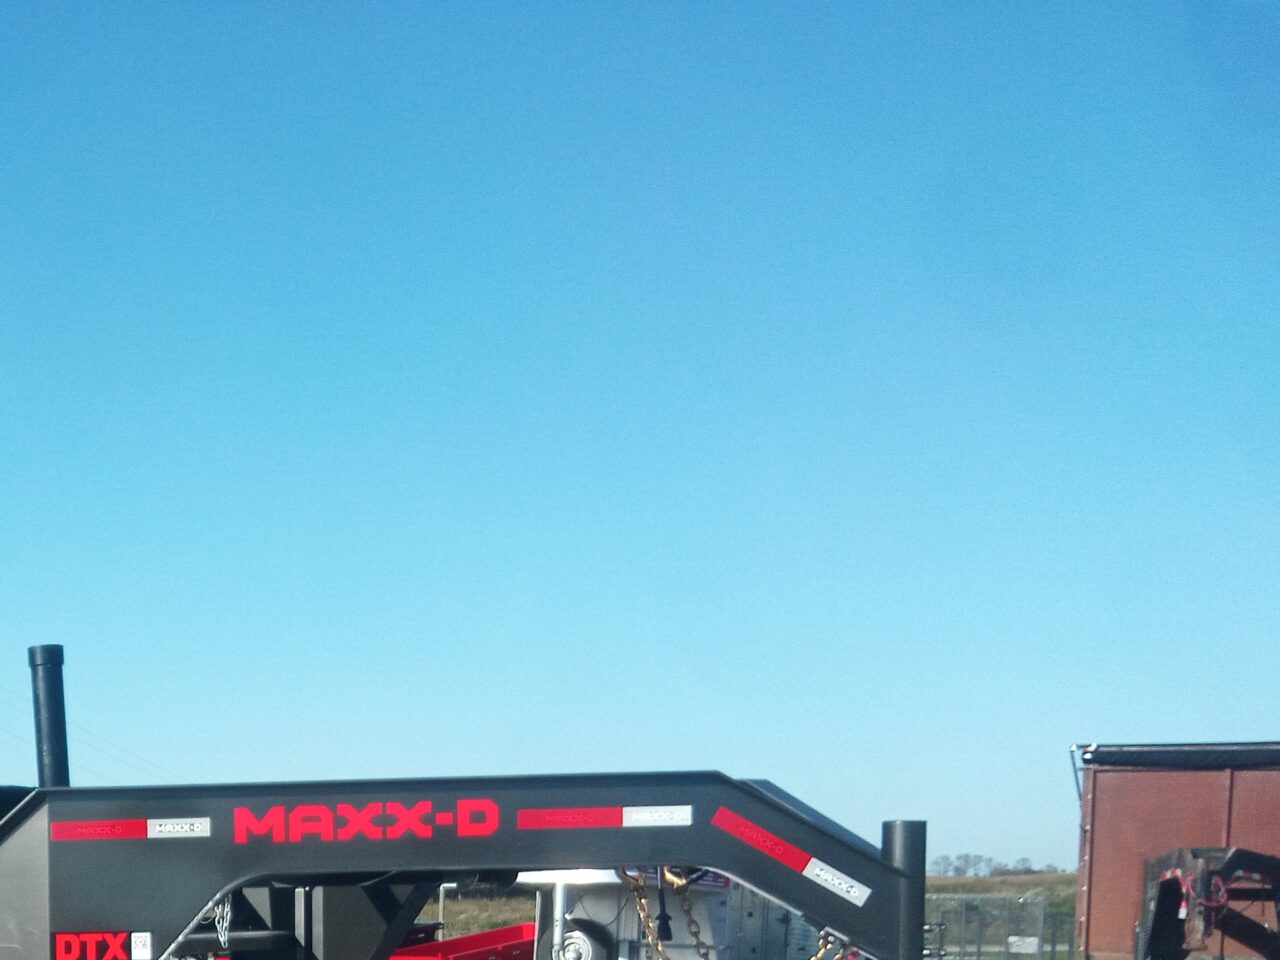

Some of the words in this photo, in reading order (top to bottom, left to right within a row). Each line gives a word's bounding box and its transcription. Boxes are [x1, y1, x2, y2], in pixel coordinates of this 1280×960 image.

[155, 823, 202, 833] MAXX-D
[233, 798, 500, 844] MAXX-D
[813, 866, 859, 897] MAXX-D
